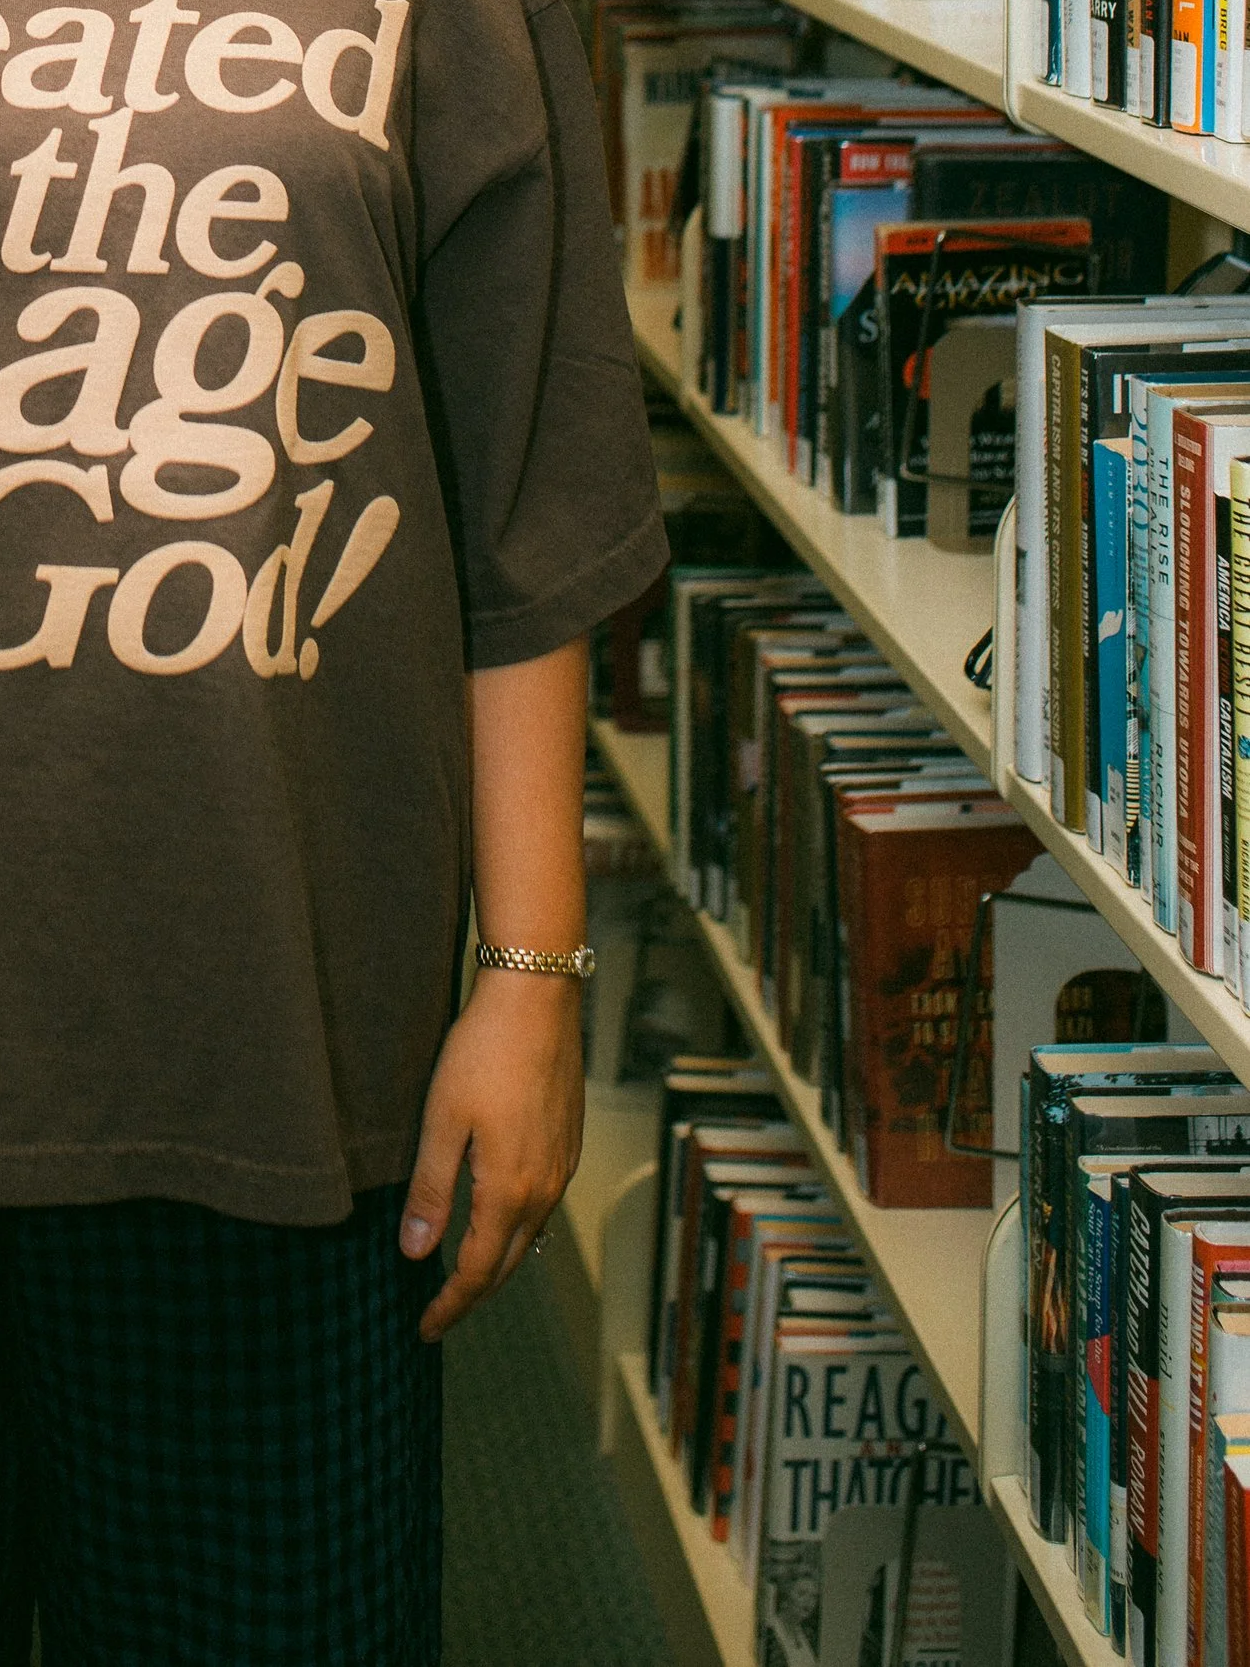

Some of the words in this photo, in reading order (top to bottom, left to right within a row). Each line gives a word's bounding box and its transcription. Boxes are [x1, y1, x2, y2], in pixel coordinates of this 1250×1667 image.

[1126, 8, 1136, 47] WAY
[0, 107, 291, 278] the
[1050, 353, 1062, 460] CAPITALISM
[1081, 401, 1089, 421] OK
[1081, 426, 1089, 444] TO
[1050, 462, 1061, 502] AND
[1081, 446, 1089, 466] BE
[1158, 456, 1169, 509] THE
[1050, 506, 1061, 534] ITS
[1081, 521, 1089, 567] ABOUT
[1178, 483, 1192, 609] SLOUCHING
[1233, 497, 1250, 541] THE
[1050, 538, 1061, 611] CRITICS
[1158, 523, 1169, 586] RISE
[1081, 571, 1090, 658] CAPITALISM
[1217, 554, 1231, 630] AMERICA
[1233, 556, 1250, 630] GREAT
[1177, 618, 1191, 731] TOWARDS
[1234, 640, 1250, 717] RESET
[1177, 737, 1191, 819] UTOPIA
[1219, 696, 1233, 800] CAPITALISM
[1155, 742, 1165, 848] RUCHIR
[1241, 838, 1250, 890] RICHARD
[1096, 1207, 1105, 1268] Chicken
[1129, 1200, 1151, 1309] CATCH
[1095, 1272, 1103, 1313] Soup
[1126, 1292, 1140, 1355] AND
[1190, 1263, 1205, 1353] HAVING
[1093, 1339, 1102, 1365] the
[1094, 1315, 1103, 1339] for
[1158, 1301, 1173, 1380] maid
[1126, 1350, 1150, 1433] KILL
[1190, 1390, 1203, 1432] ALL
[1129, 1436, 1146, 1536] RONAN
[1158, 1430, 1166, 1536] STEPHANIE
[1157, 1542, 1165, 1596] LAND
